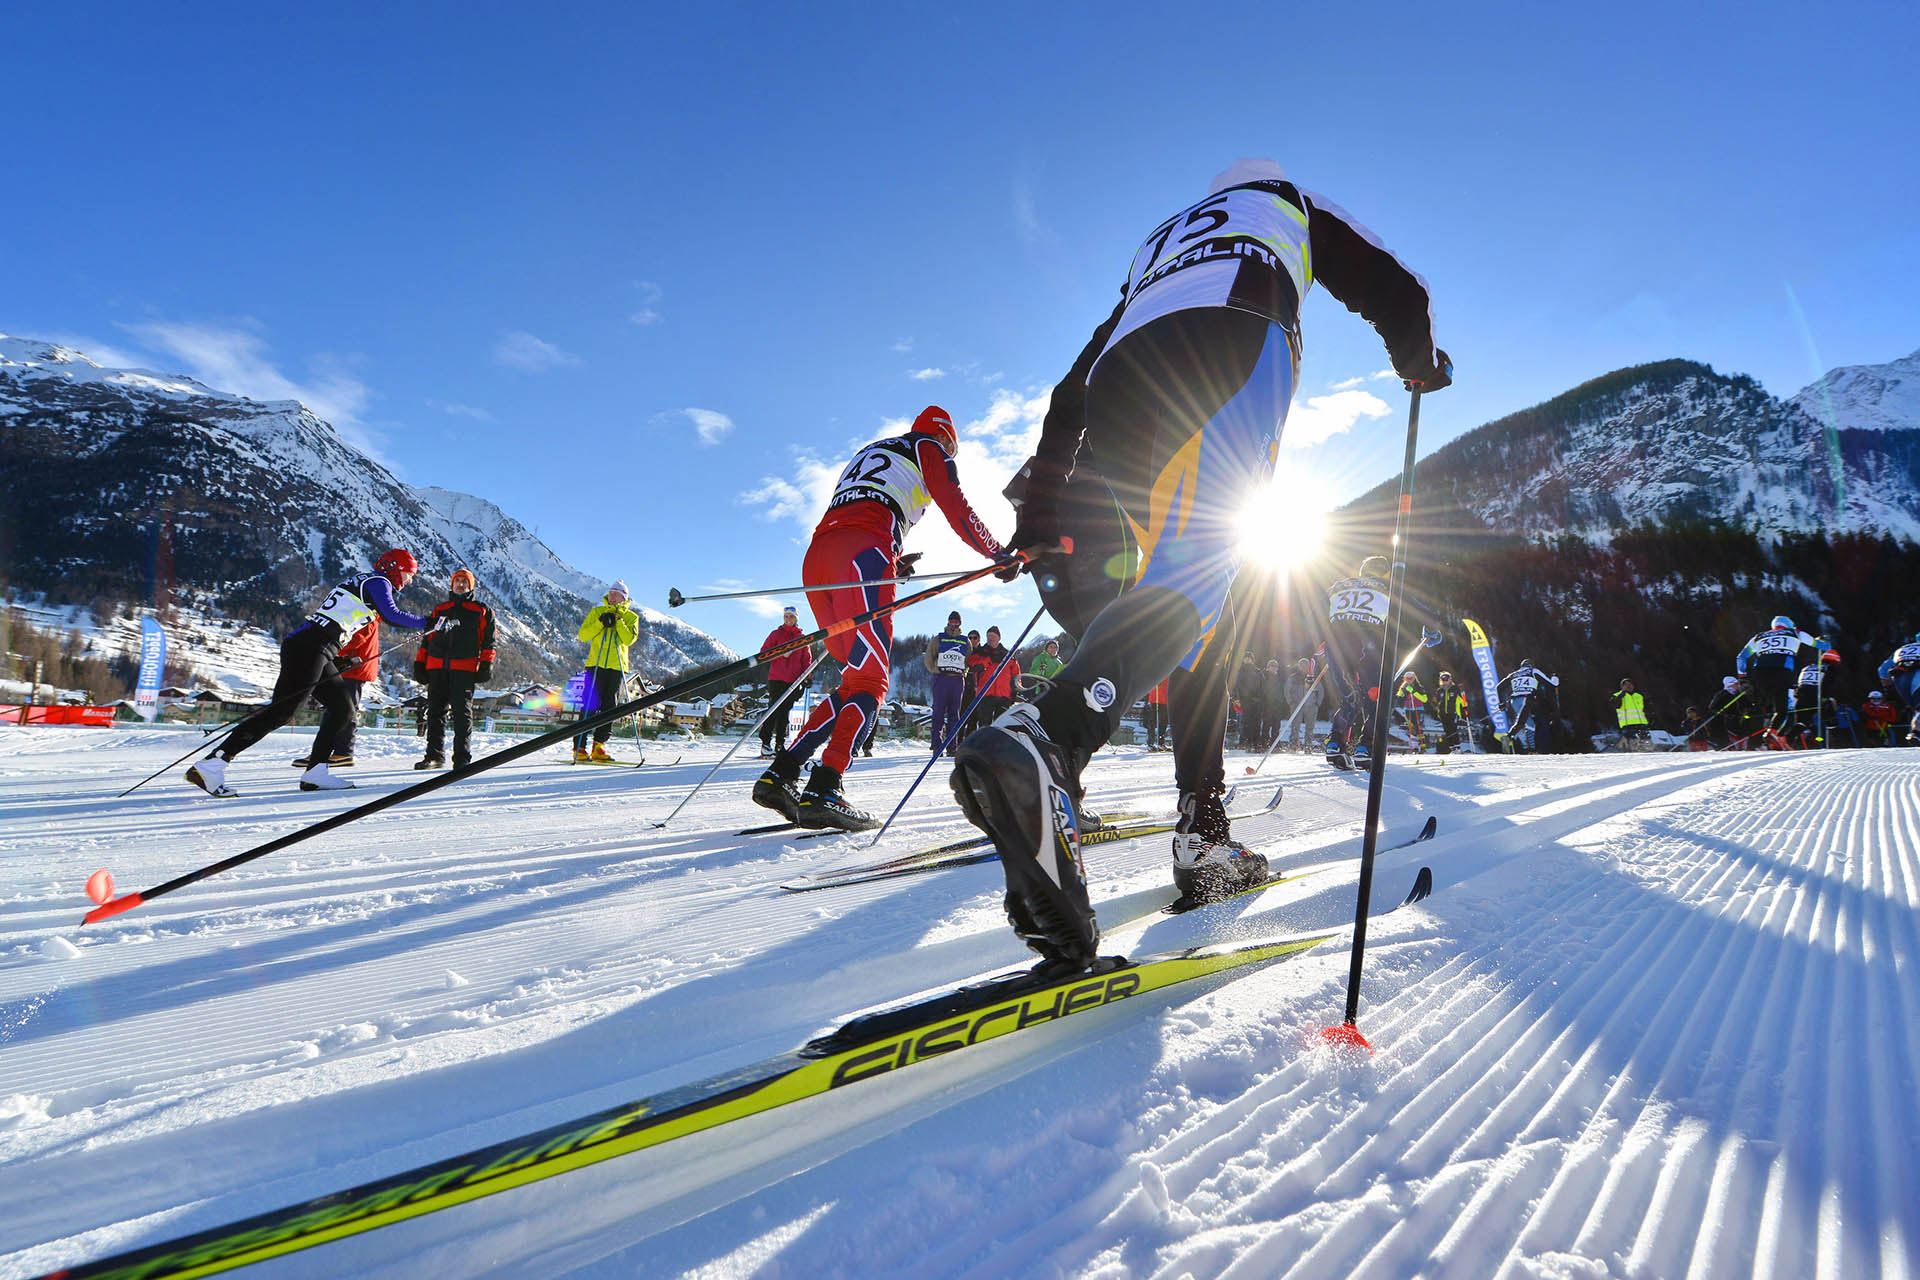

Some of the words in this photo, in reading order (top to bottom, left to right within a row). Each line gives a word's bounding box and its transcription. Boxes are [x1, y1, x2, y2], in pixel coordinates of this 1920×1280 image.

[1142, 195, 1229, 275] 75
[835, 452, 892, 491] 42
[1336, 591, 1375, 612] 312
[1760, 637, 1788, 650] 351
[831, 972, 1141, 1090] FISCHER
